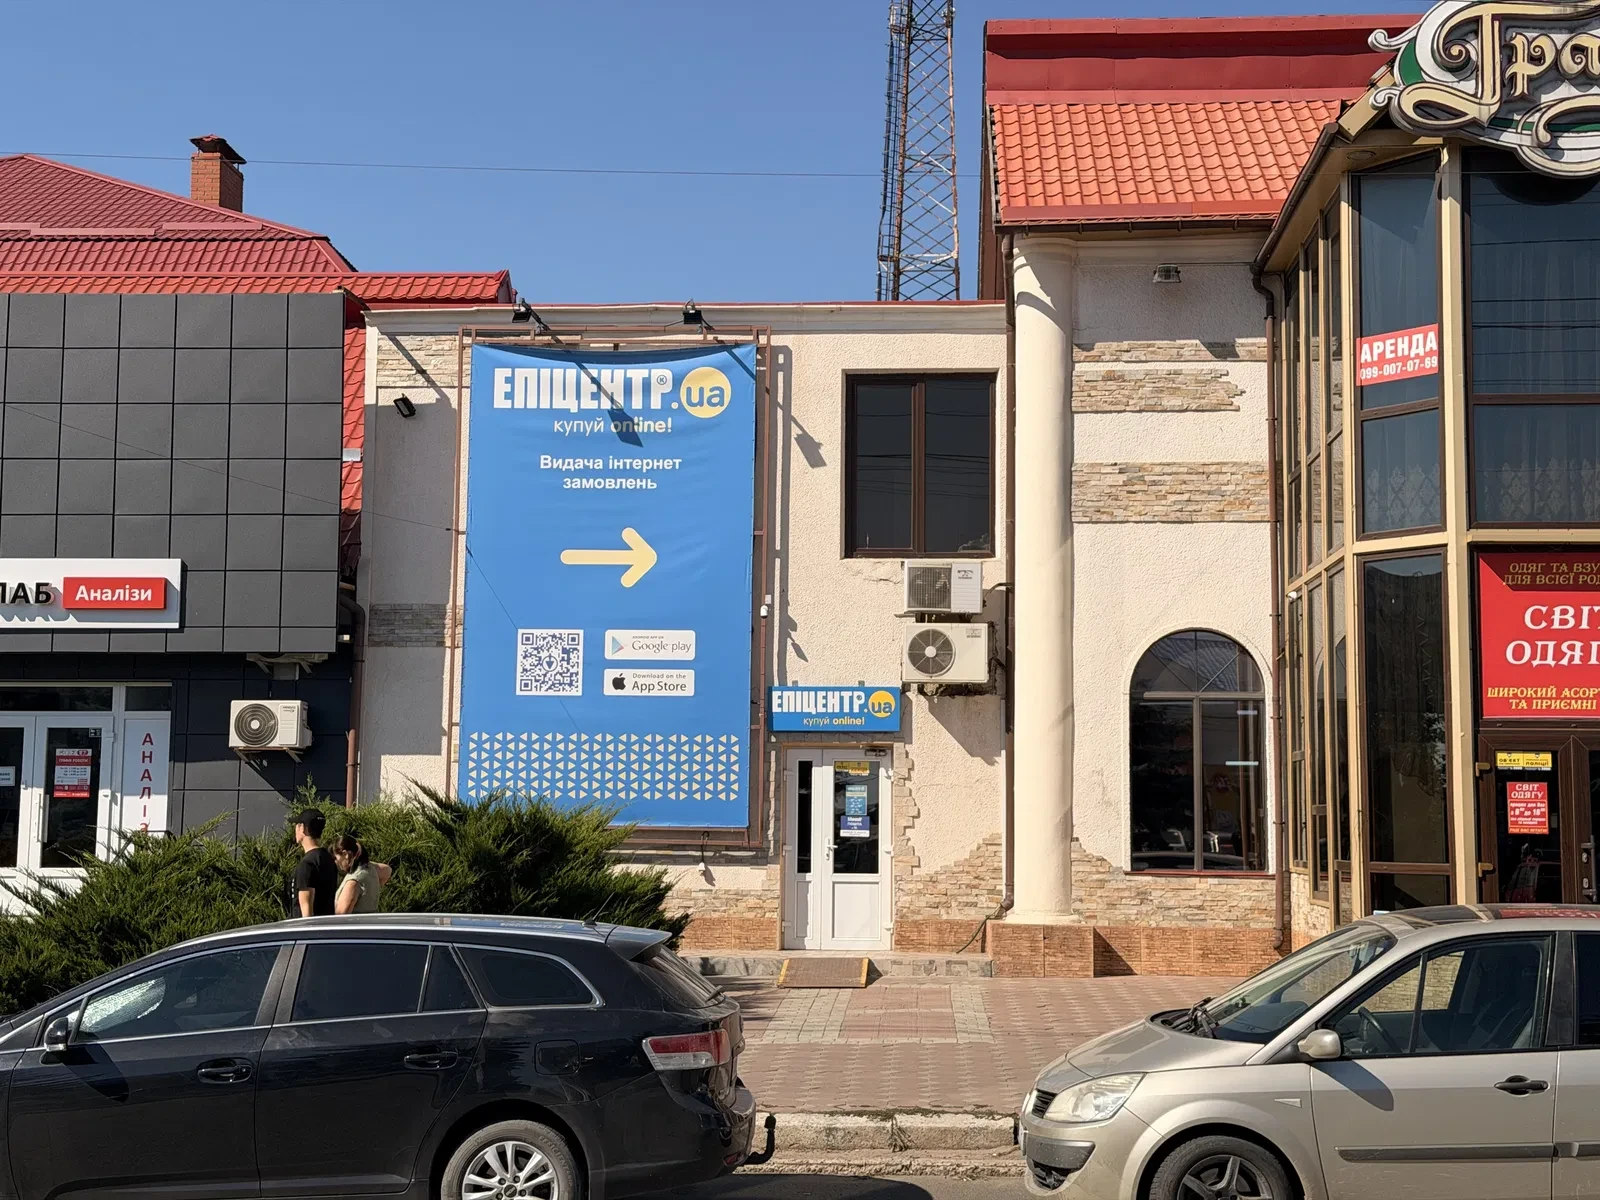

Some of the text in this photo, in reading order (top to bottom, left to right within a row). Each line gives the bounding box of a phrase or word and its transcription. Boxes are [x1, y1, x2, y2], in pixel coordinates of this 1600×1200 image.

[1360, 331, 1438, 364] АРЕНДА
[1360, 356, 1438, 380] 099-007-07-69
[553, 417, 673, 437] купуй online!
[540, 455, 682, 472] Видача інтернет
[563, 476, 658, 489] замовлень
[1509, 562, 1546, 574] ОДЯГ
[1550, 562, 1569, 573] ТА
[1505, 574, 1531, 585] ДЛЯ
[1536, 572, 1575, 585] ВСІЄЇ
[75, 586, 153, 602] Аналізи
[631, 640, 692, 653] Google play
[632, 681, 687, 693] App Store
[1487, 685, 1557, 698] ШИРОКИЙ
[1509, 699, 1597, 710] ТА ПРИЄМНІ
[803, 717, 865, 726] купуй online!
[1515, 783, 1539, 791] СВІТ
[1511, 791, 1544, 799] ОДЯГУ
